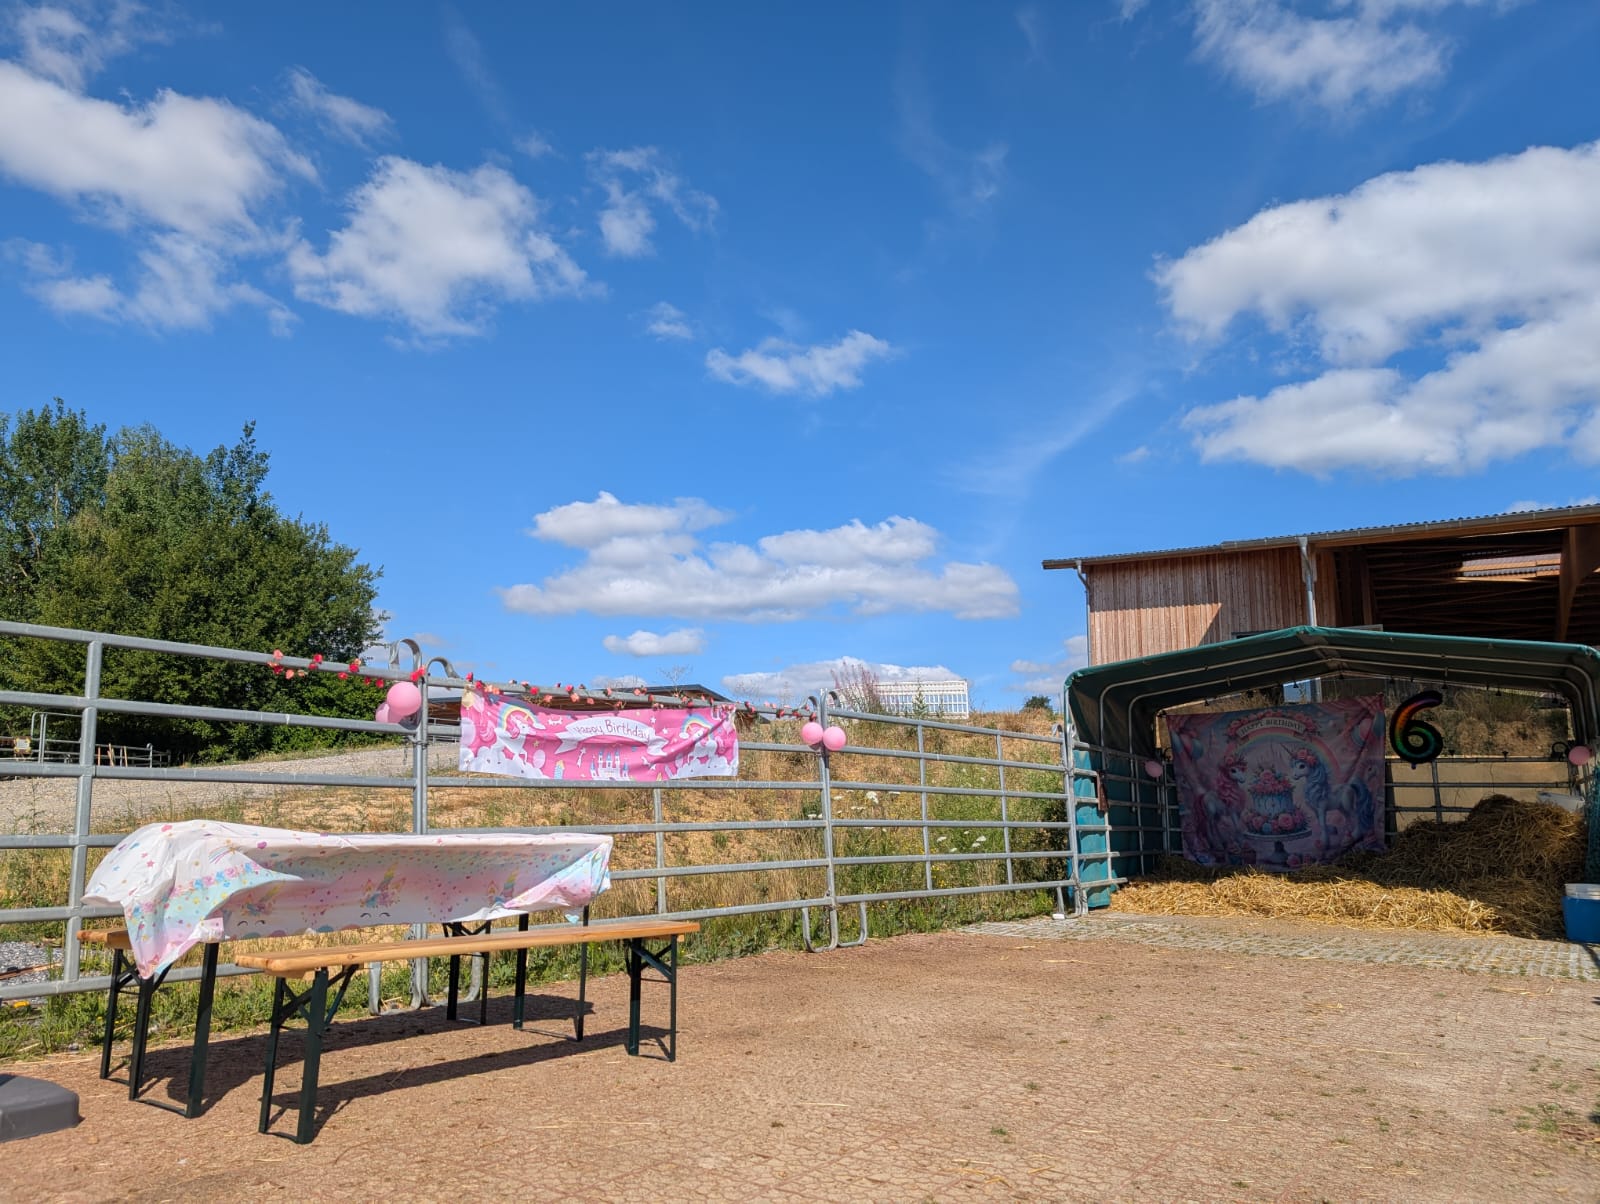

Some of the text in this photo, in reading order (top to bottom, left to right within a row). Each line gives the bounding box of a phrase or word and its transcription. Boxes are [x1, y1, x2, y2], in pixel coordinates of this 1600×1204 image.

[604, 719, 650, 742] Birthday
[1240, 720, 1264, 735] HAPPY
[1390, 690, 1443, 764] 6
